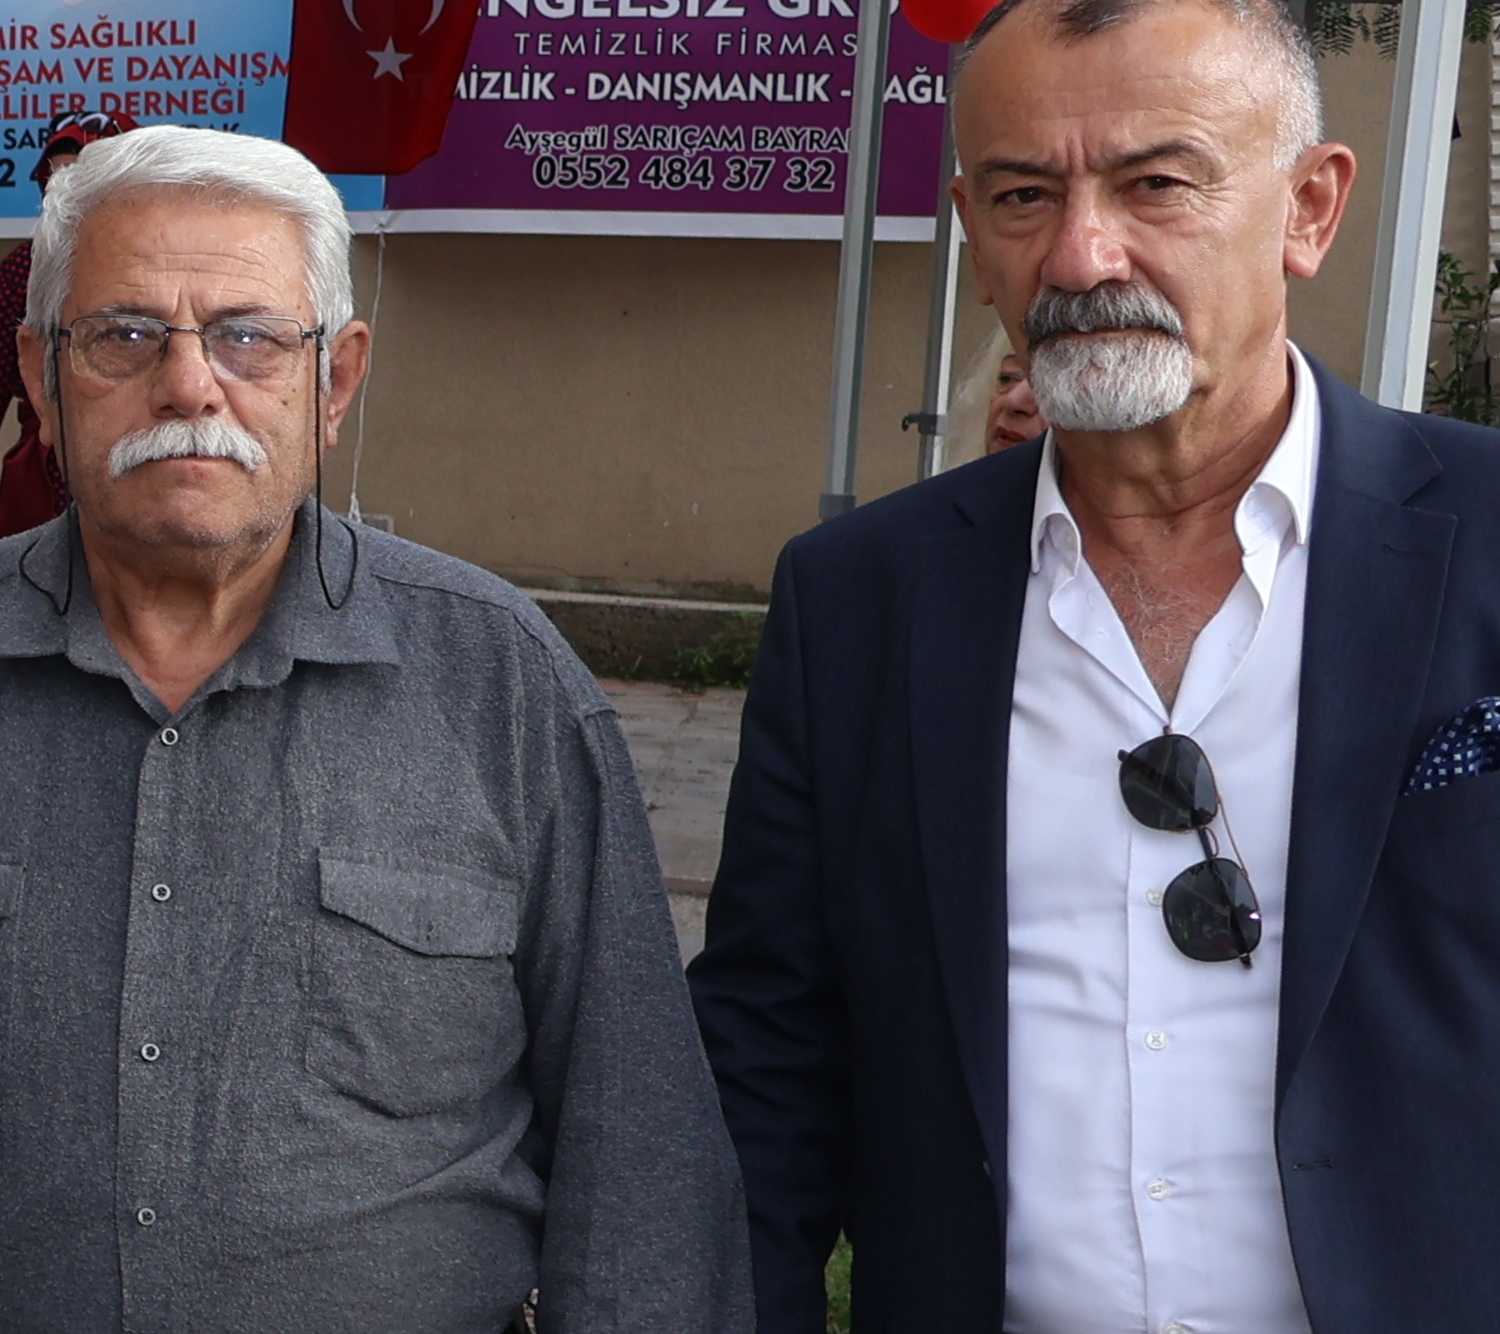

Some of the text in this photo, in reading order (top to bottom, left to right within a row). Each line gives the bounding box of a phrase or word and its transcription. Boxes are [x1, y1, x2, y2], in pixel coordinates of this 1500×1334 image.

[50, 14, 197, 50] SAĞLIKLI
[514, 28, 858, 57] TEMİZLİK FİRMAS
[73, 56, 114, 84] VE
[126, 52, 290, 87] DAYANIŞM
[586, 71, 831, 109] DANIŞMANLIK
[883, 66, 947, 105] AĞL
[100, 80, 245, 117] DERNEĞİ
[505, 124, 850, 156] Ayşegül SARIÇAM BAYRA
[534, 154, 836, 193] 0552 484 37 32
